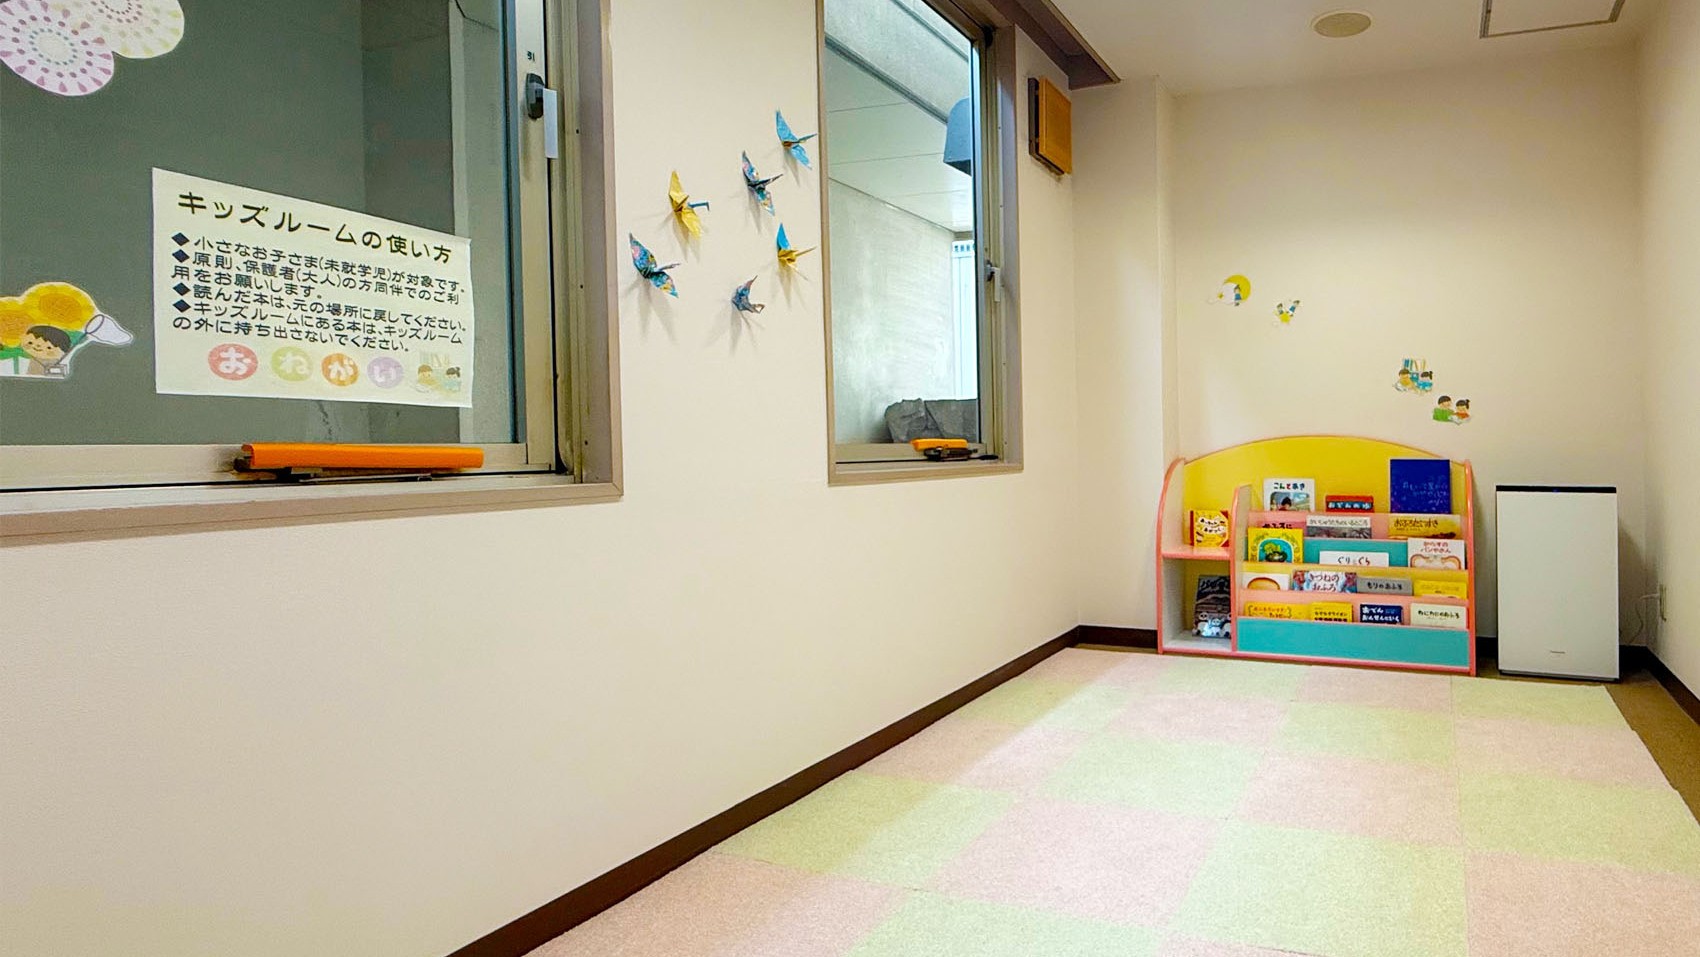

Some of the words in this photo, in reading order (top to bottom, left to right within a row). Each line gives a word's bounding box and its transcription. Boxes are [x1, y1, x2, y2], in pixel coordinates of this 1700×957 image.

[178, 191, 452, 264] キッズルームの使い方
[171, 265, 323, 300] 用をお願いします。
[192, 251, 459, 306] 原則、保護者(大人)の方同伴でのご利
[194, 236, 465, 293] 小さなお子さま(未就学児)が対象です。
[193, 284, 467, 332] 読んだ本は、元の場所に戻してください。
[193, 301, 463, 345] キッズルームにある本は、キッズルーム
[172, 316, 409, 352] の外に持ち出さないでください。
[1273, 482, 1306, 491] こんとあき
[1367, 582, 1403, 590] もりのおふろ
